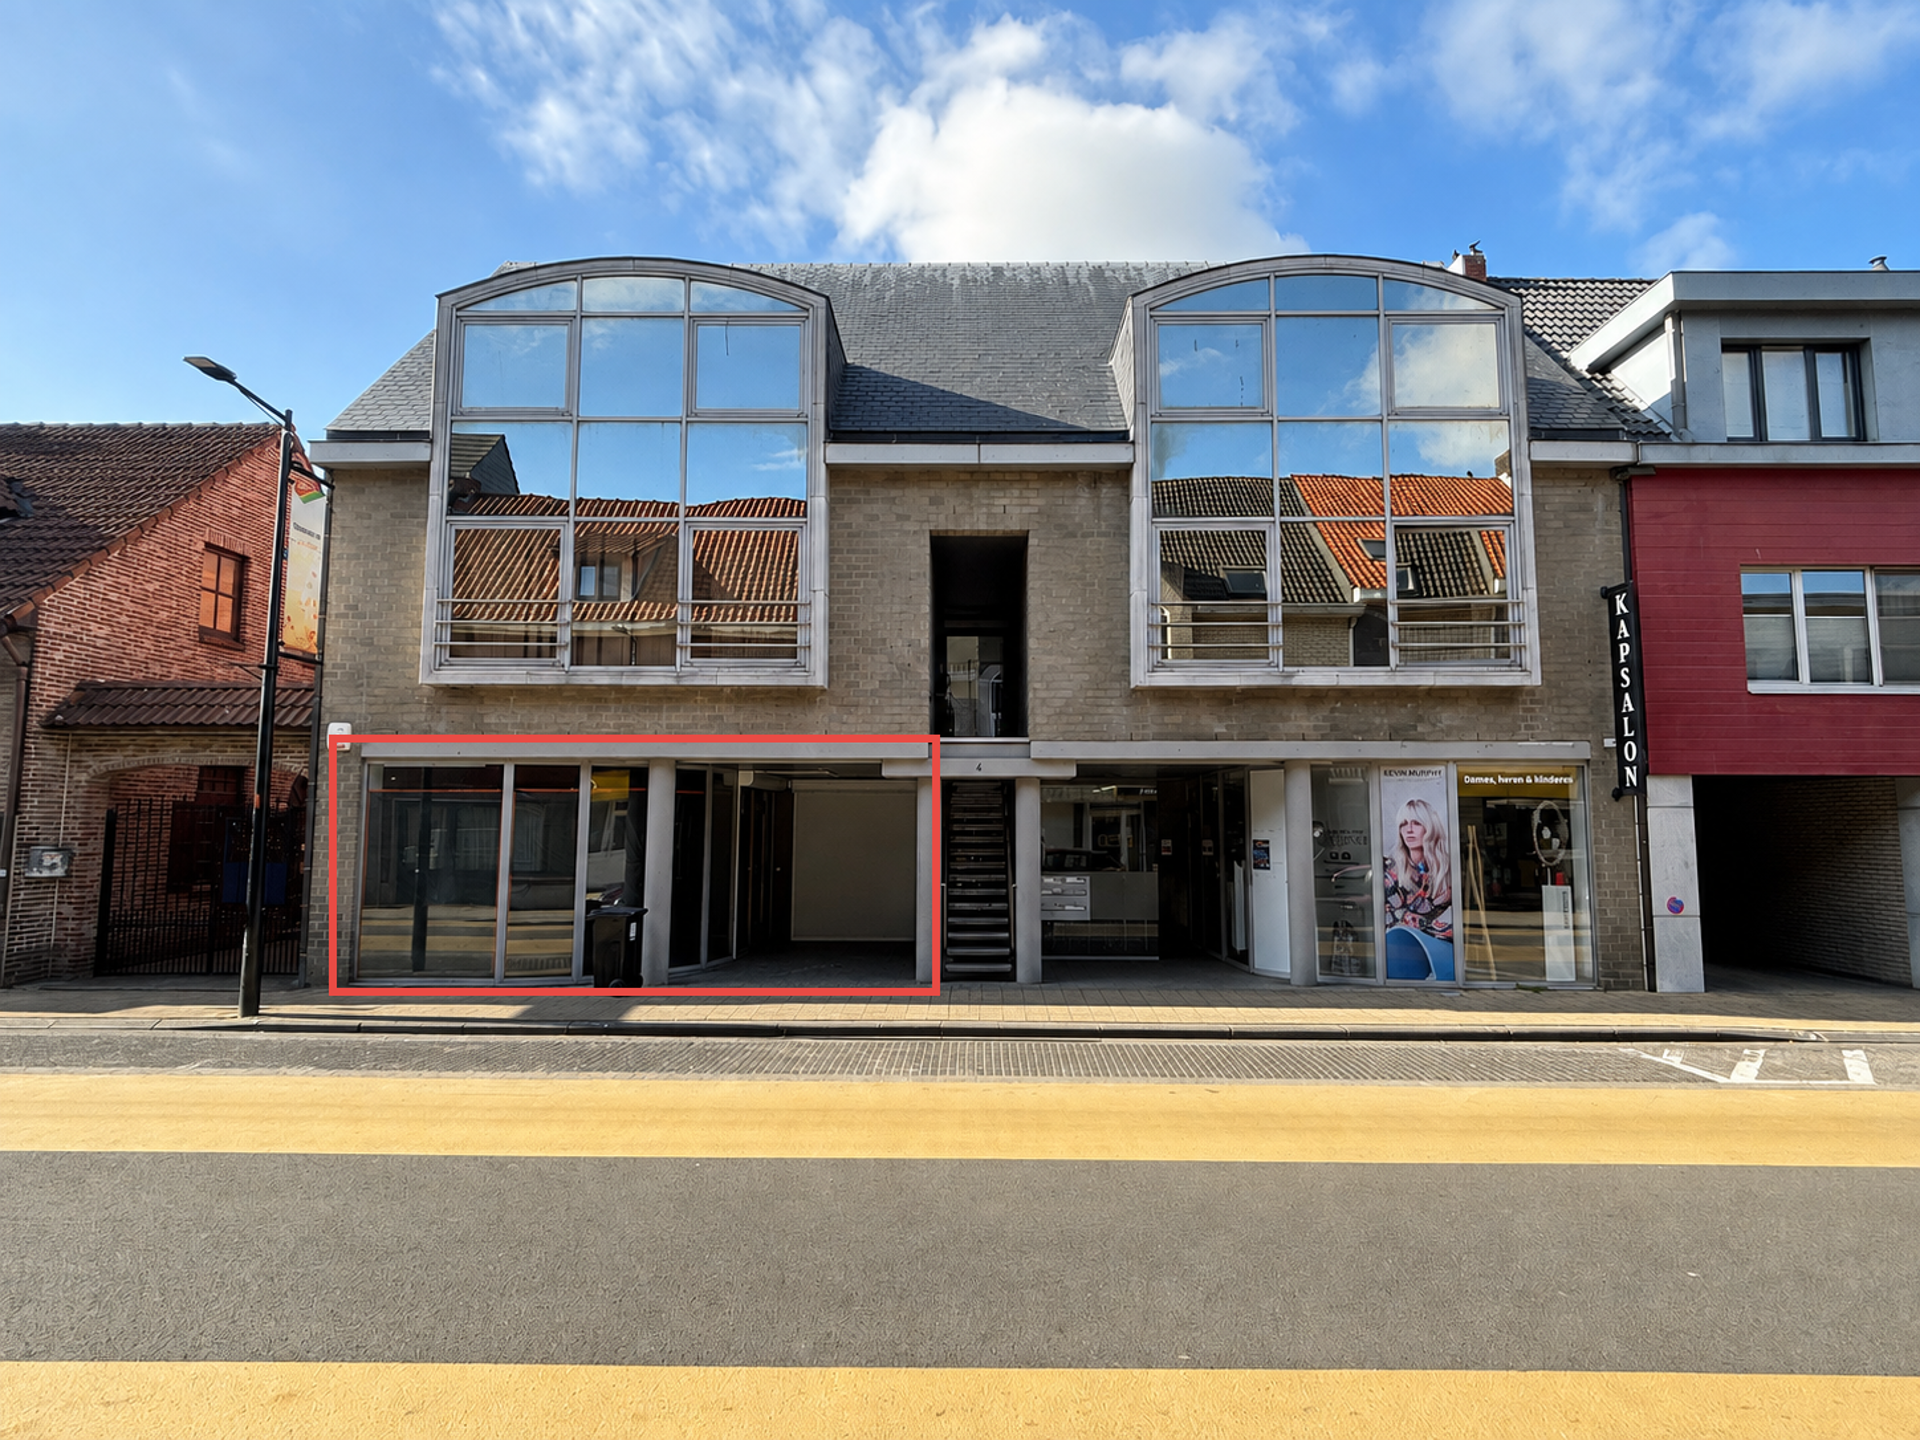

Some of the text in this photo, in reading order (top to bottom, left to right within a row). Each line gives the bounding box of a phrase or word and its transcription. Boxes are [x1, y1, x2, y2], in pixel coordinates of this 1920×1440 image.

[1614, 592, 1638, 788] KAPSALON
[975, 761, 982, 772] 4
[1463, 775, 1497, 785] Dames,
